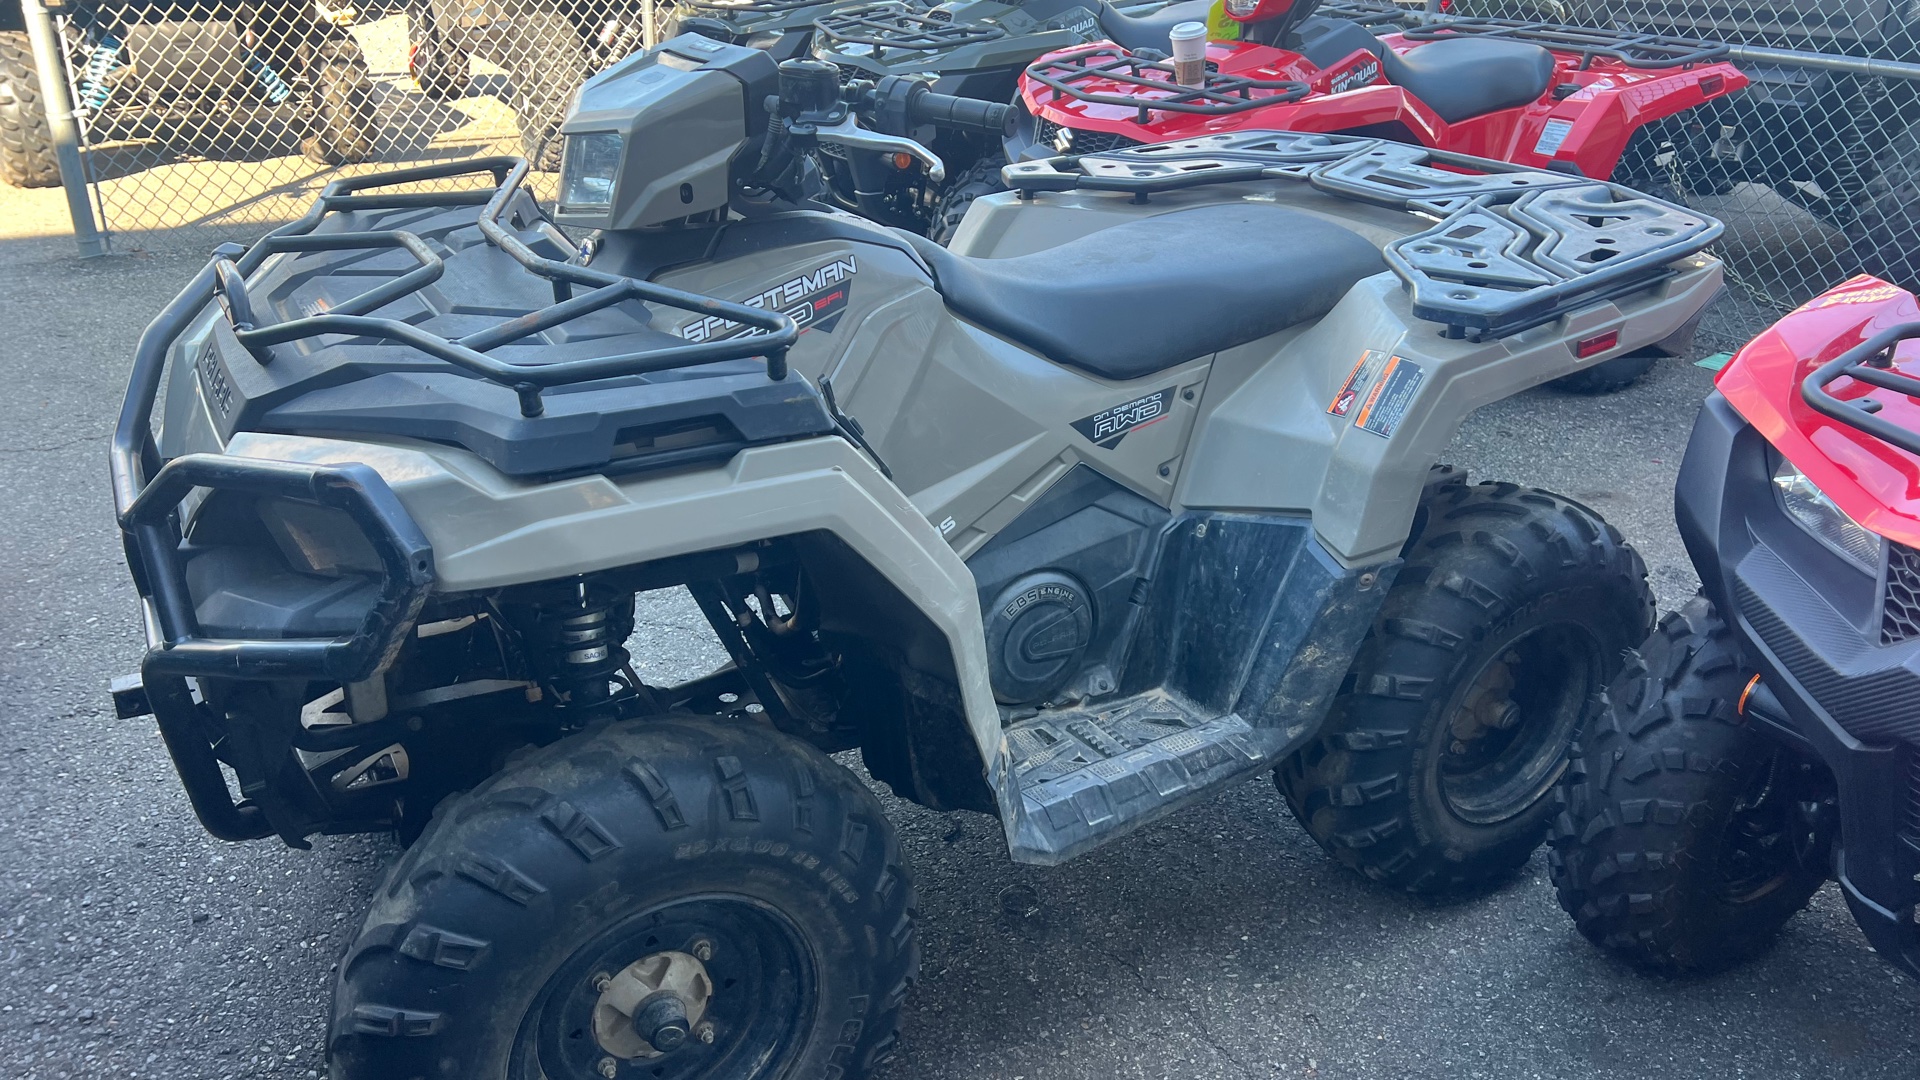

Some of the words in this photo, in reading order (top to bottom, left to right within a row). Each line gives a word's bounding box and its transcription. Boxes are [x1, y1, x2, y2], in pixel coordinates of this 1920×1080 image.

[1070, 17, 1094, 34] QUAD
[814, 290, 843, 310] EFI
[1370, 372, 1390, 404] WARNING
[1093, 411, 1110, 422] ON
[1113, 393, 1162, 415] DEMAND
[1094, 400, 1162, 439] AWD
[1006, 590, 1038, 617] EBS
[1040, 586, 1076, 602] ENGINE
